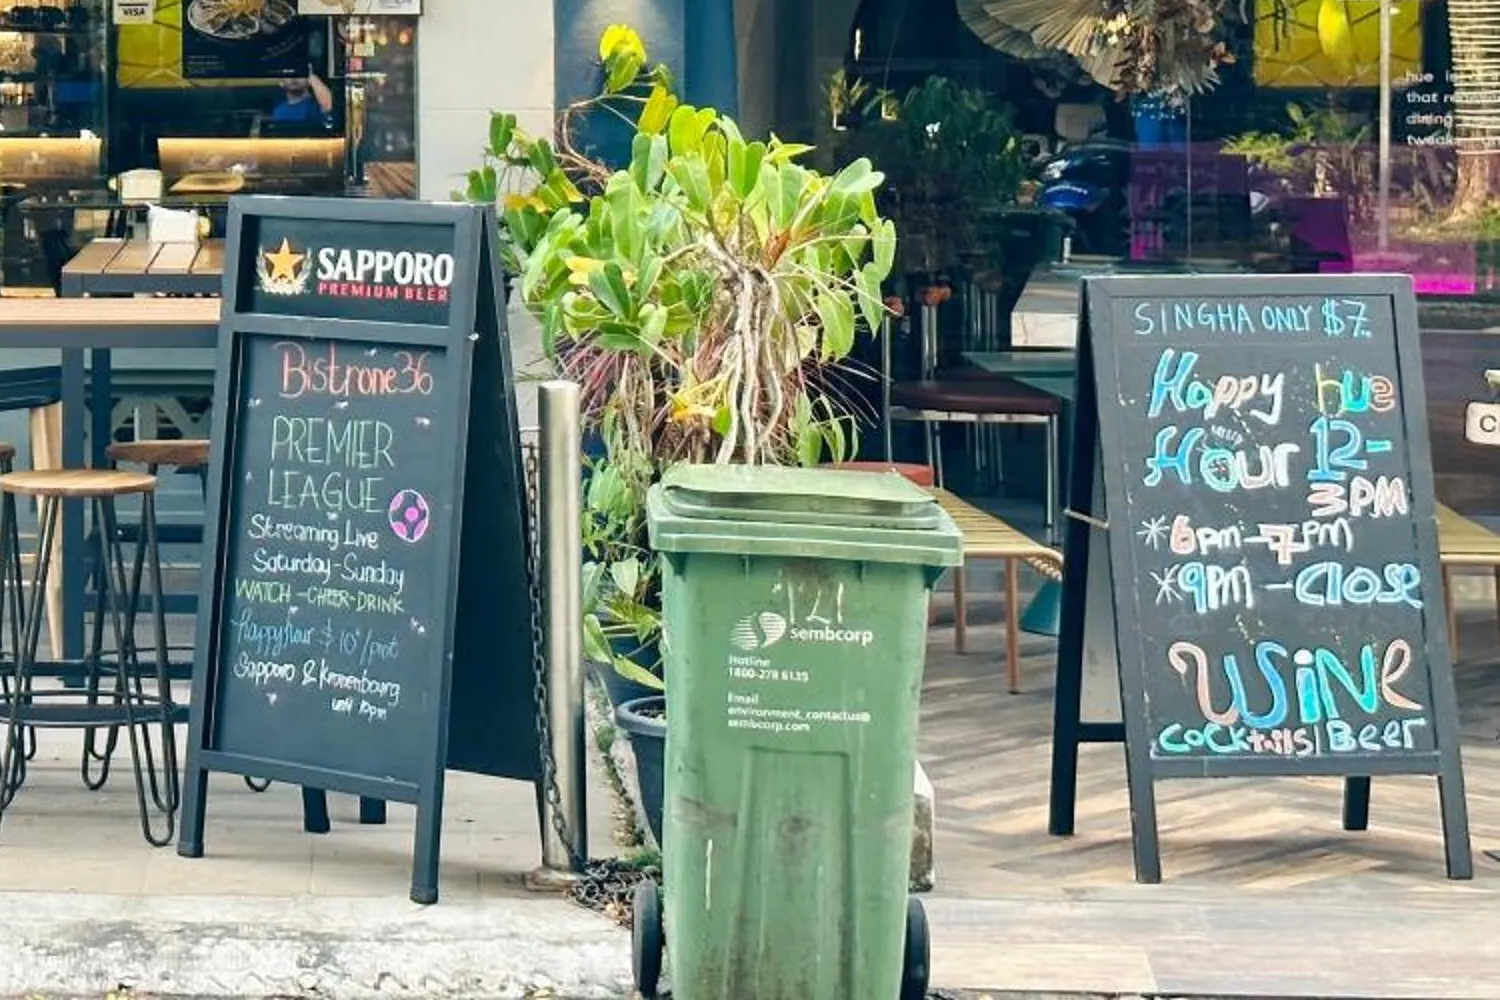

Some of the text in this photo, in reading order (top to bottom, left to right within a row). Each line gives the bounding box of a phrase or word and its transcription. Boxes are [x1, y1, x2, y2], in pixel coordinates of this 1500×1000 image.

[122, 8, 146, 17] VISA
[1406, 70, 1434, 82] hue
[1406, 91, 1438, 103] that
[317, 247, 454, 287] SAPPORO
[318, 283, 448, 302] PREMIUM BEER
[1134, 303, 1255, 335] SINGHA
[1261, 304, 1313, 332] ONLY
[1148, 347, 1396, 426] Happy hue
[271, 415, 395, 469] PREMIER
[267, 469, 384, 513] LEAGUE
[248, 513, 380, 550] Streaming Live
[233, 651, 296, 686] Sapporo
[728, 655, 771, 667] Hotline
[727, 692, 759, 704] Email
[1327, 718, 1426, 751] Beer
